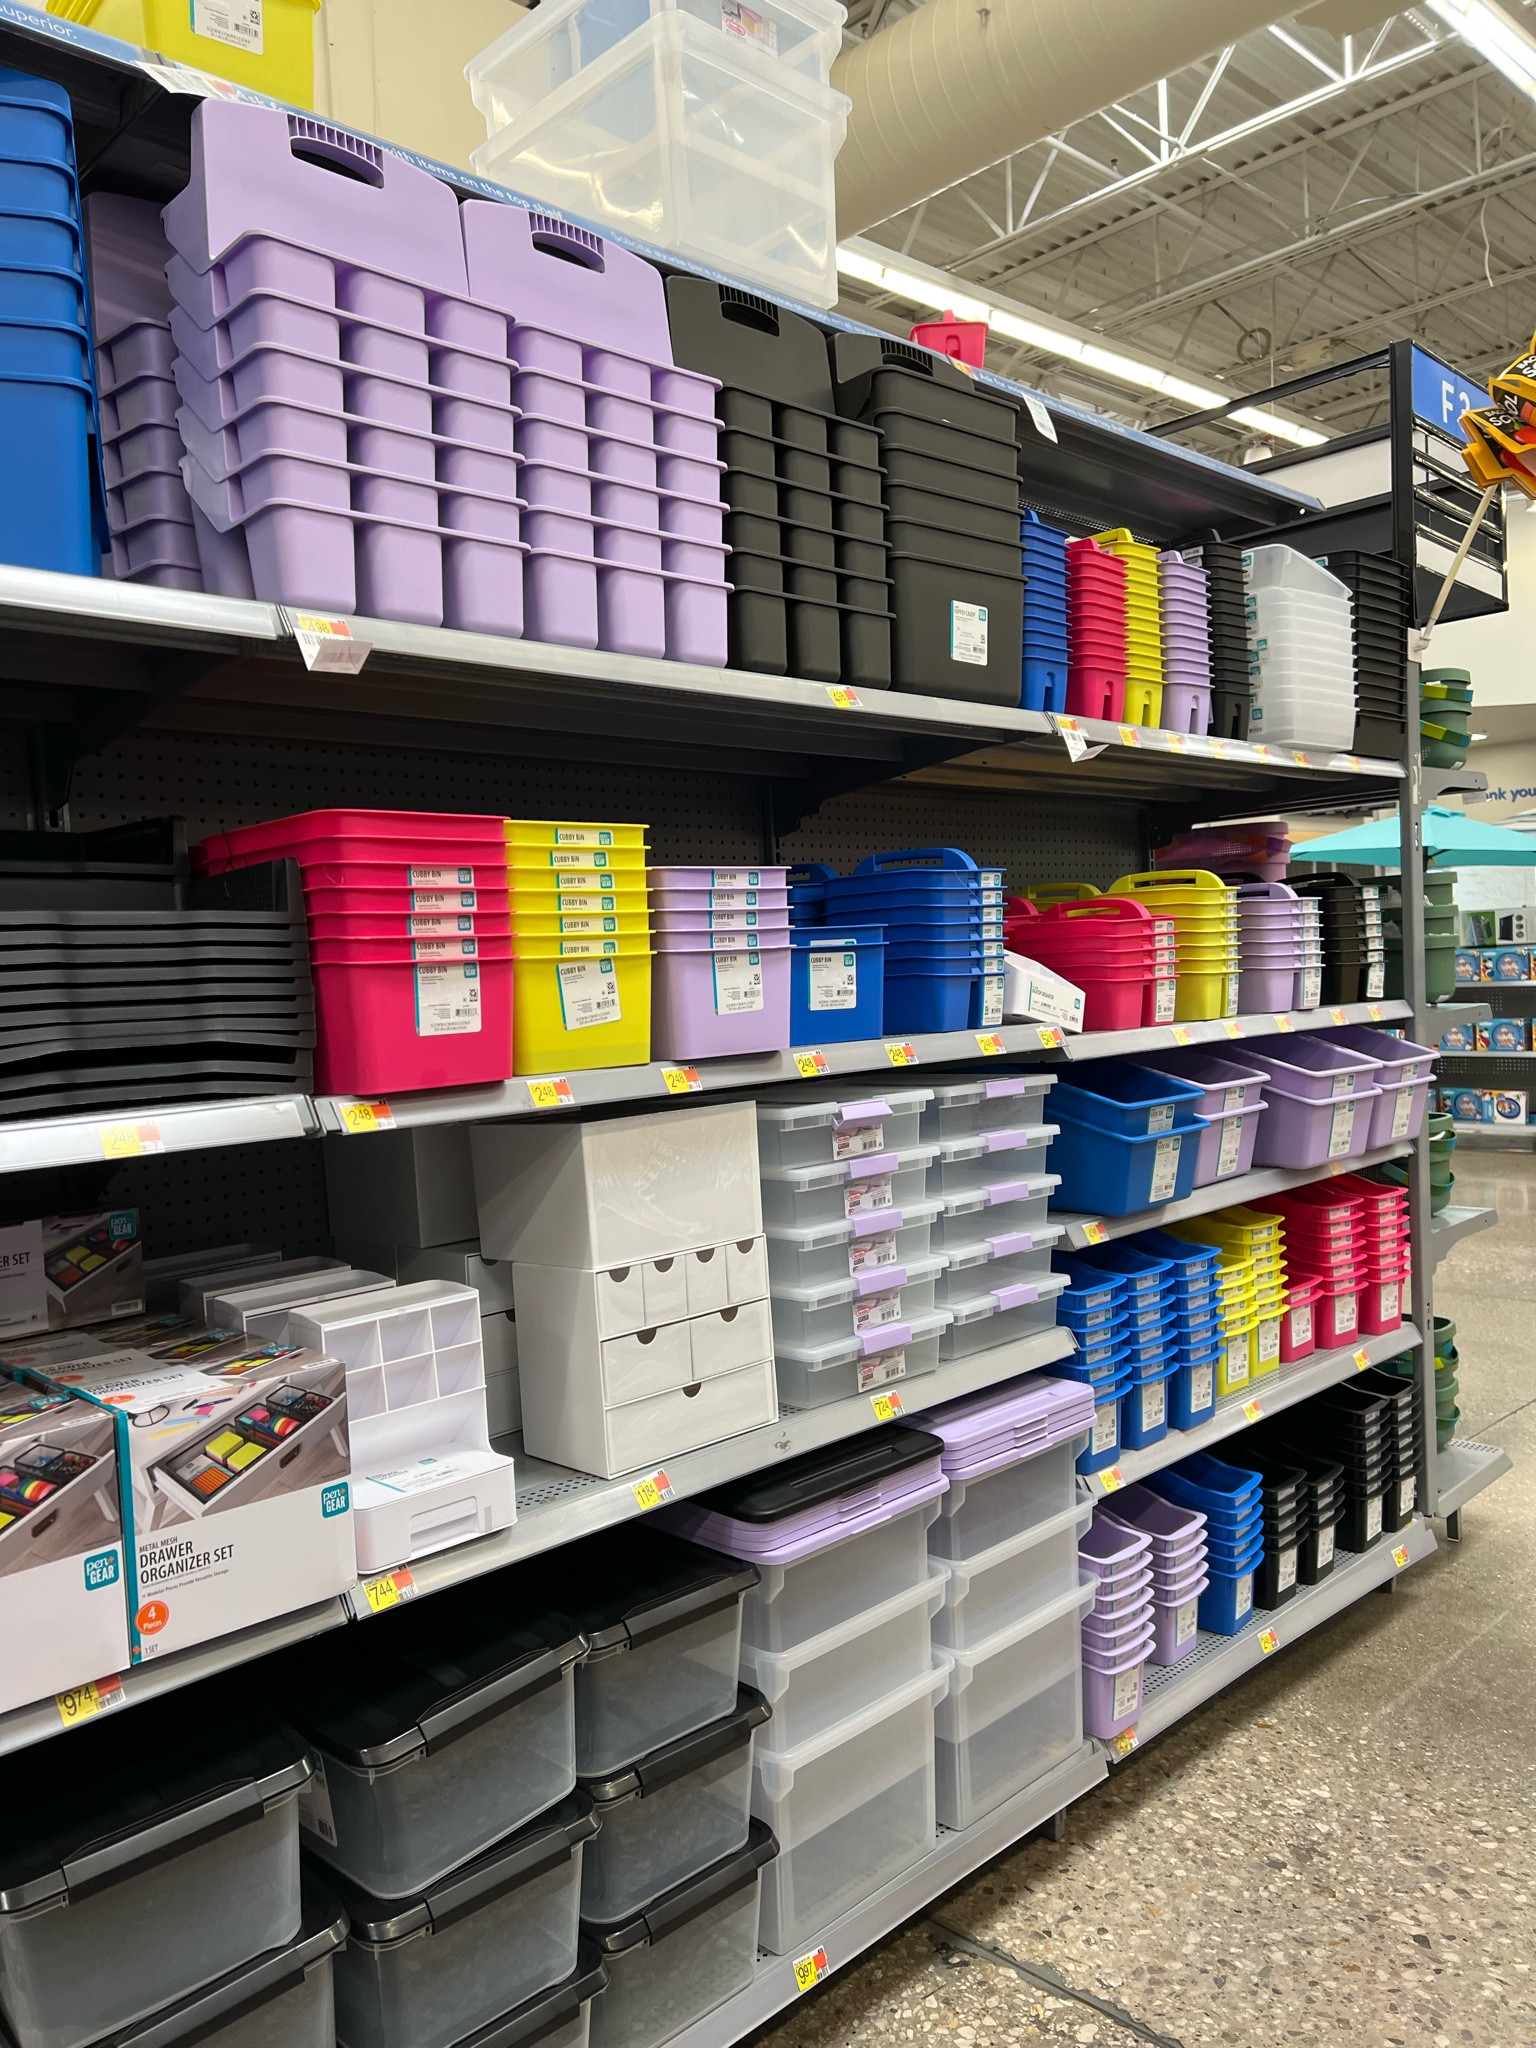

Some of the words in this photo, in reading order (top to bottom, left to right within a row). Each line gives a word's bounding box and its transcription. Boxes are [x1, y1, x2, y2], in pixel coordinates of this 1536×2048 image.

[418, 156, 457, 180] items
[460, 176, 479, 189] on
[480, 182, 504, 198] the
[507, 192, 530, 209] top
[559, 833, 575, 841] CUBBY
[576, 833, 585, 841] BIN
[413, 870, 431, 878] CUBBY
[432, 870, 441, 878] BIN
[560, 877, 576, 885] CUBBY
[416, 895, 433, 903] CUBBY
[435, 894, 444, 902] BIN
[413, 918, 431, 926] CUBBY
[564, 921, 579, 929] CUBBY
[417, 942, 434, 950] CUBBY
[564, 946, 580, 954] CUBBY
[418, 966, 436, 974] CUBBY
[437, 965, 447, 973] BIN
[561, 967, 577, 975] CUBBY
[577, 965, 586, 973] BIN
[114, 1223, 132, 1236] GEAR
[13, 1252, 31, 1264] SET
[326, 1495, 346, 1513] GEAR
[139, 1542, 159, 1553] METAL
[161, 1536, 178, 1547] MESH
[140, 1541, 193, 1568] DRAWER
[141, 1552, 211, 1585] ORGANIZER
[214, 1544, 234, 1563] SET
[90, 1566, 115, 1585] GEAR
[147, 1588, 165, 1598] Modular
[165, 1584, 178, 1592] Pieces
[179, 1579, 194, 1589] Provide
[195, 1573, 213, 1583] Versatile
[213, 1569, 229, 1578] Storage
[148, 1606, 156, 1620] 4
[143, 1620, 163, 1631] Pieces
[148, 1644, 159, 1654] SET
